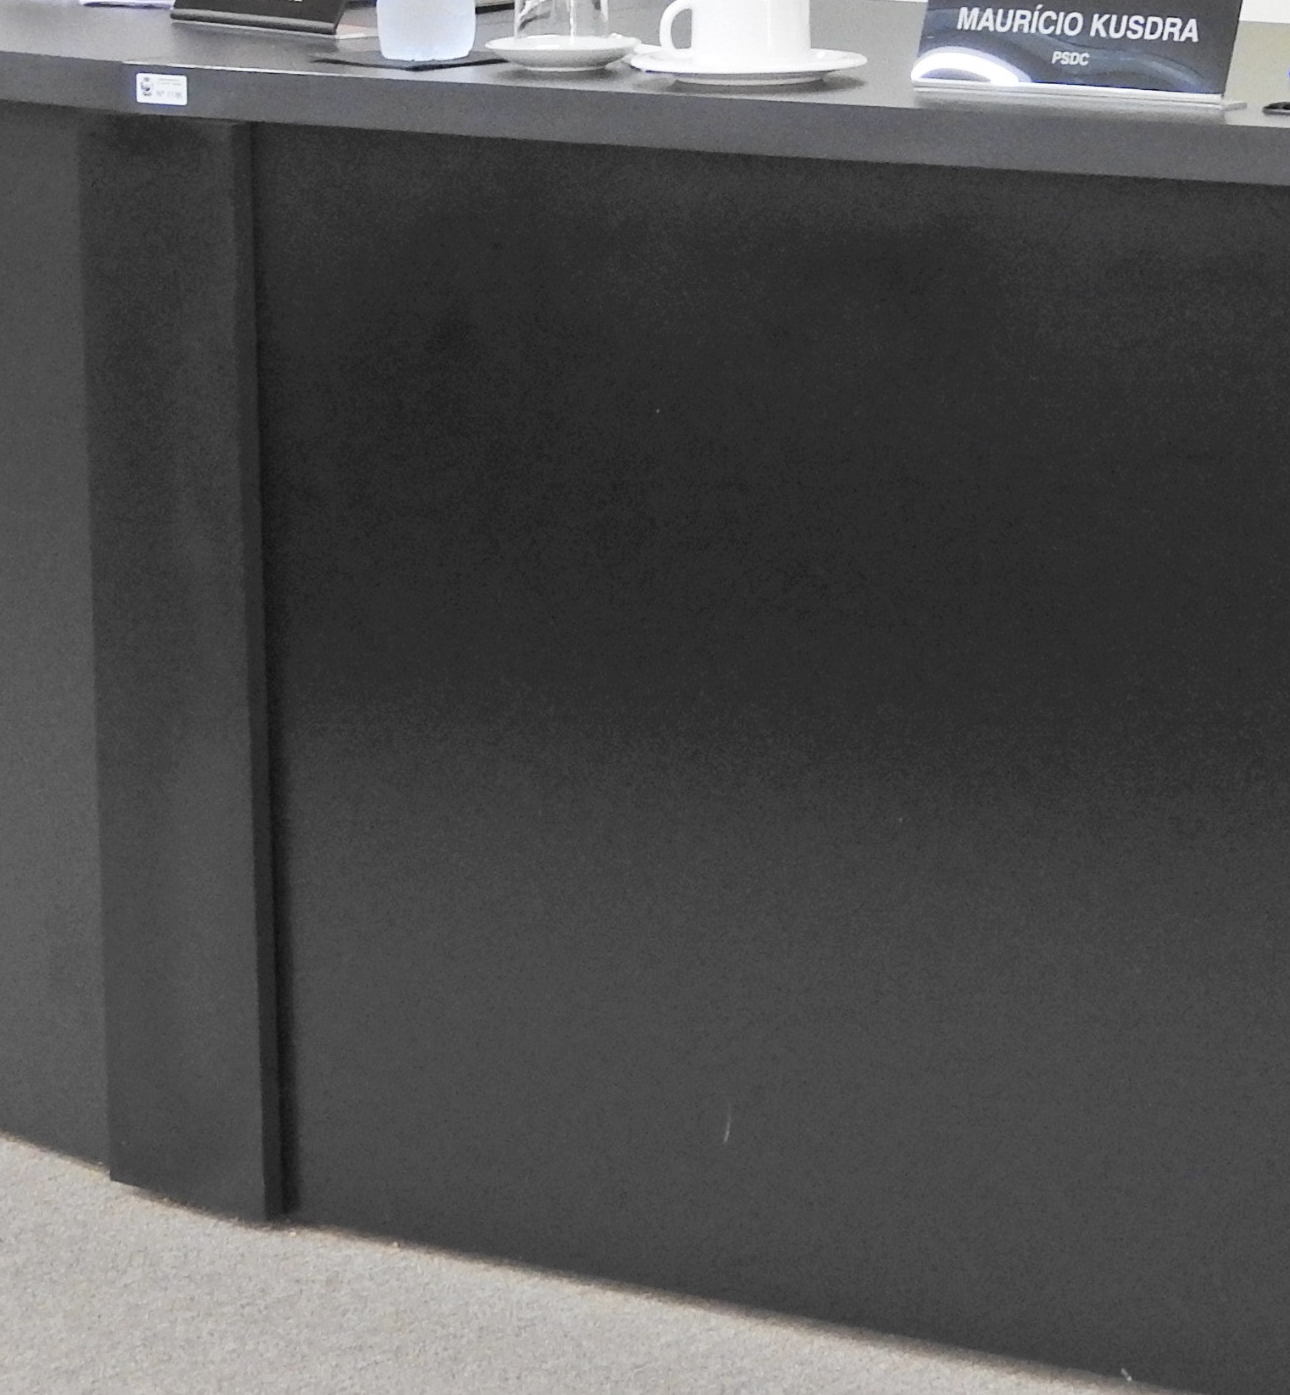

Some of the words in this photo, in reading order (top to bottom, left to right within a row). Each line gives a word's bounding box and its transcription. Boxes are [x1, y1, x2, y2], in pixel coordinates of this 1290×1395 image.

[956, 3, 1084, 37] MAURÍCIO
[1089, 13, 1199, 43] KUSDRA
[1051, 50, 1091, 67] PSDC
